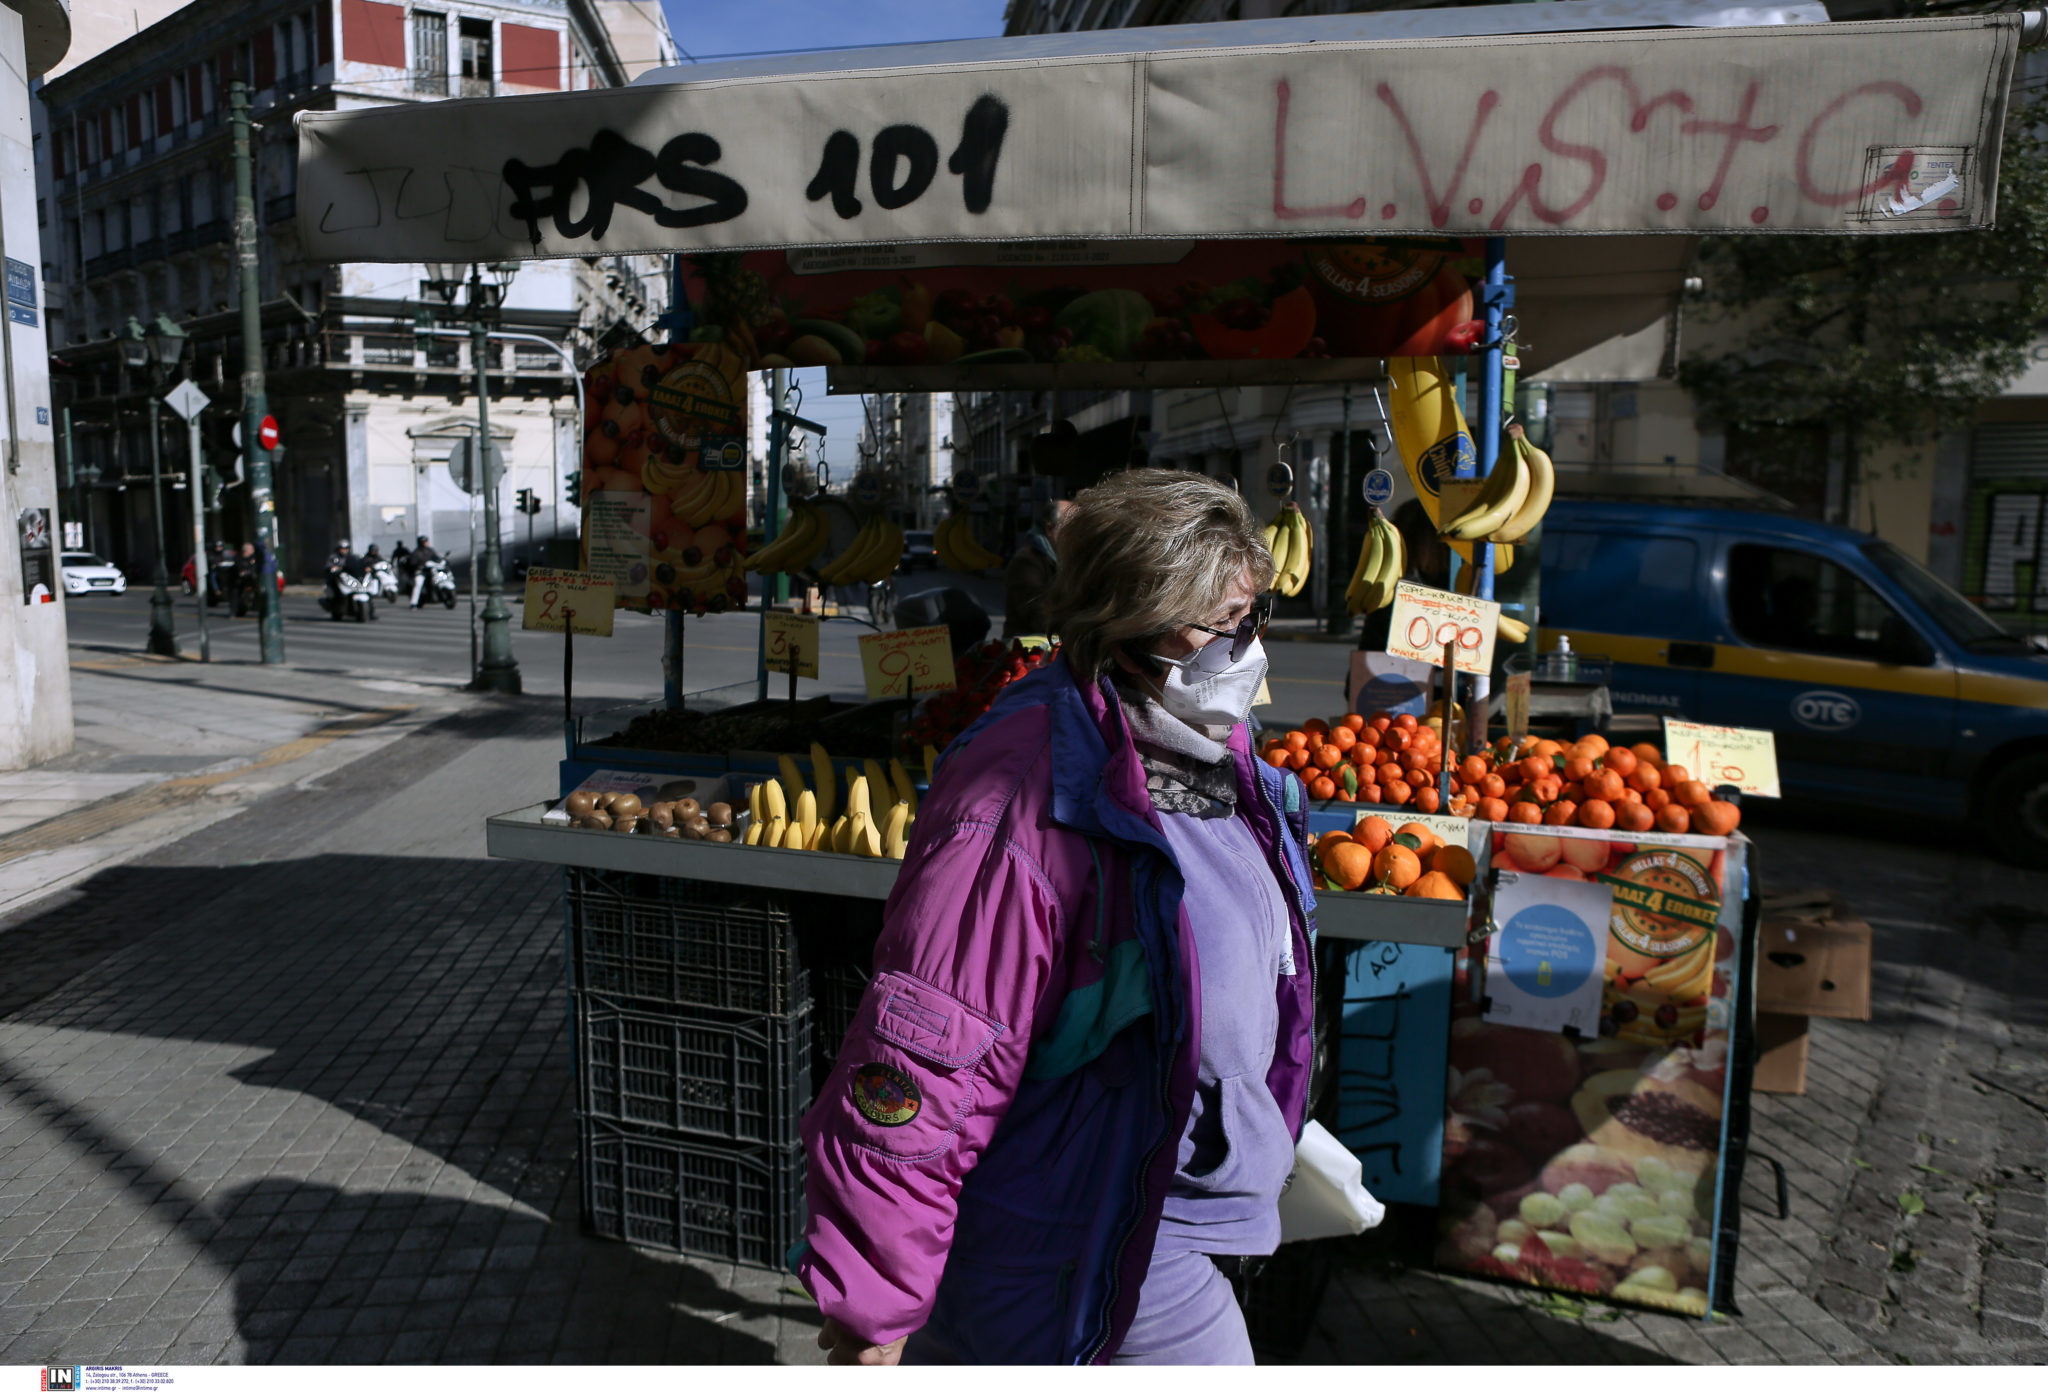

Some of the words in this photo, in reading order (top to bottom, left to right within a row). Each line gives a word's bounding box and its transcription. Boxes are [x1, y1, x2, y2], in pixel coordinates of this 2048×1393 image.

[806, 95, 1012, 219] 101
[1316, 258, 1356, 294] HELLAS
[1355, 276, 1371, 297] 4
[1371, 268, 1425, 298] SEASONS
[681, 394, 694, 414] 4
[771, 630, 787, 656] 3
[1629, 855, 1665, 873] HELLAS
[1665, 852, 1679, 868] 4
[1606, 882, 1648, 905] ΛΛΑΣ
[1645, 890, 1664, 912] 4
[1664, 898, 1719, 925] ΕΠΟΧΕΣ
[1638, 933, 1651, 950] 4
[858, 1095, 900, 1122] COLOURS
